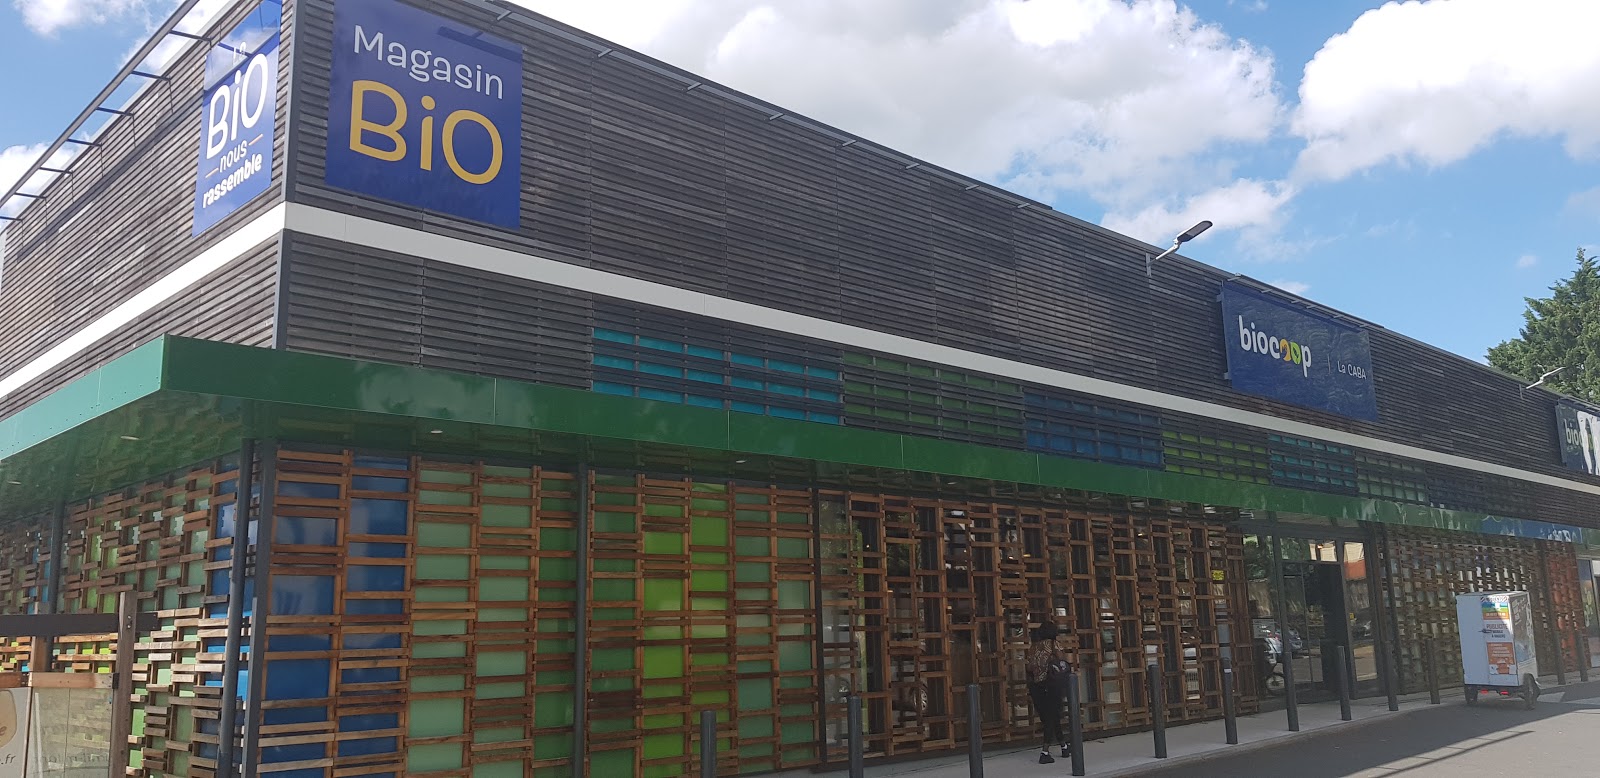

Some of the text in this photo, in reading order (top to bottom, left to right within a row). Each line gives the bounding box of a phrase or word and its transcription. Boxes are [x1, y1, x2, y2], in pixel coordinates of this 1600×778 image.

[354, 25, 503, 100] Magasin
[206, 53, 269, 160] BiO
[349, 80, 503, 185] BiO
[202, 153, 262, 209] rassemble
[219, 140, 248, 173] nous
[1238, 314, 1312, 378] biocoop
[1337, 360, 1367, 380] La CABA
